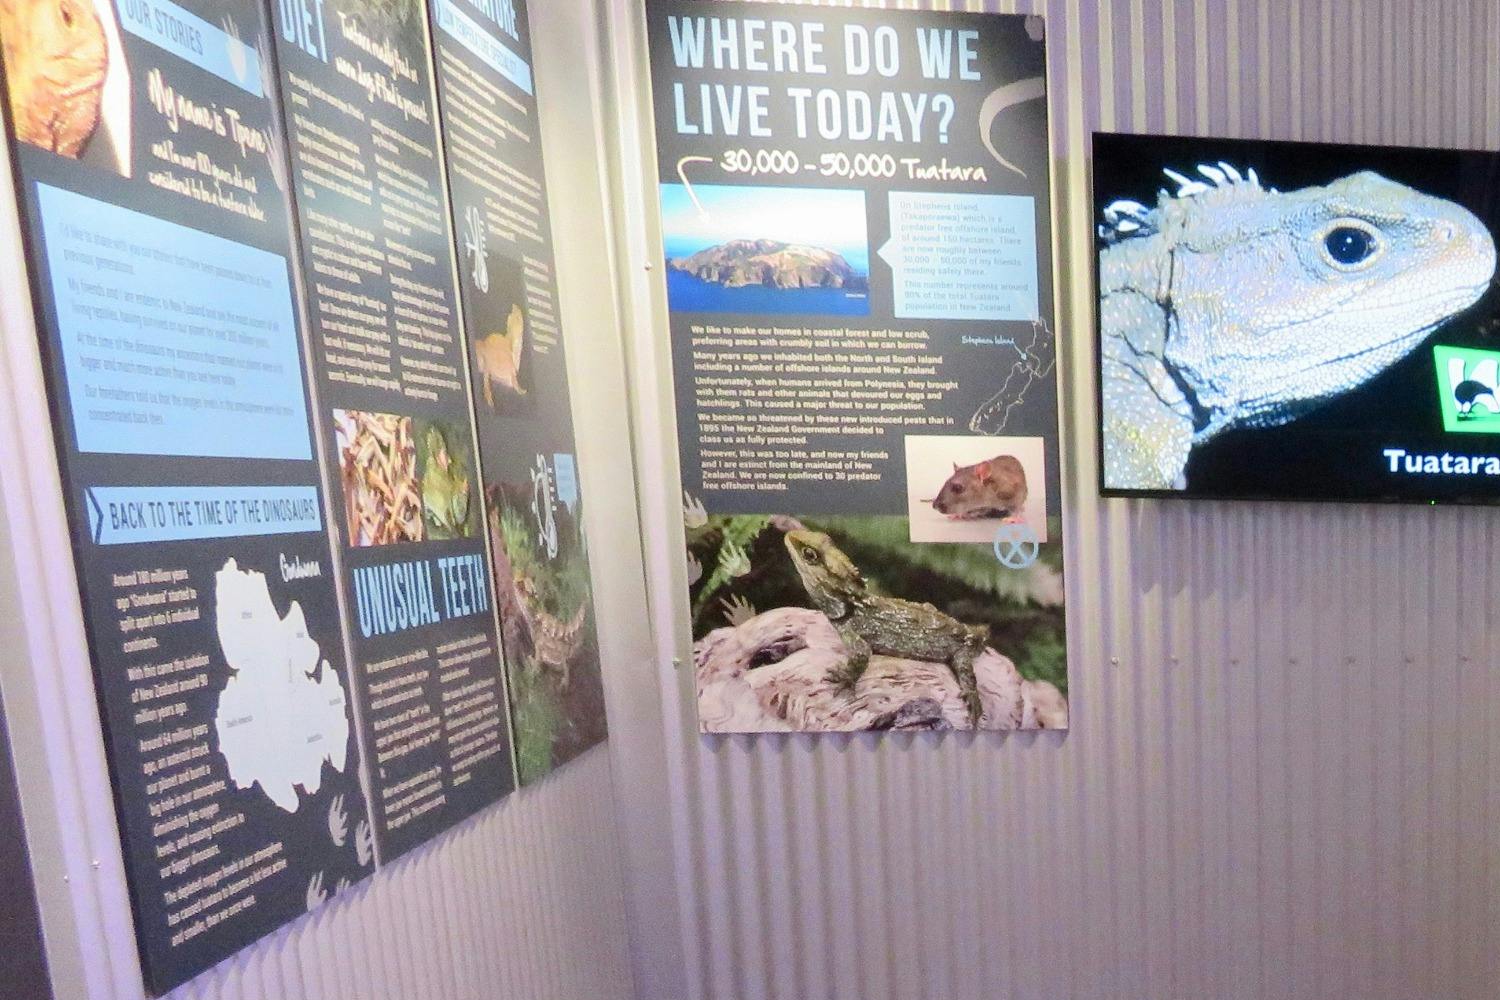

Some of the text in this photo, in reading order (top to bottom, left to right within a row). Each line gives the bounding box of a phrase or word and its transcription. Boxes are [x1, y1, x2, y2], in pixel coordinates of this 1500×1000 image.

[125, 0, 204, 56] OUR STORIES
[279, 0, 328, 64] DIET
[668, 15, 982, 81] WHERE DO WE
[674, 83, 956, 144] LIVE TODAY?
[720, 149, 799, 176] 30,000
[820, 152, 897, 180] 50,000
[900, 157, 988, 183] Tuatara
[691, 326, 704, 334] We
[705, 326, 721, 335] like
[733, 326, 757, 335] make
[773, 327, 802, 335] homes
[803, 327, 812, 335] in
[813, 327, 844, 337] coastal
[845, 328, 870, 338] forest
[871, 329, 887, 338] and
[888, 329, 903, 338] low
[904, 329, 930, 339] scrub,
[692, 336, 734, 347] preferring
[759, 338, 778, 346] with
[779, 339, 813, 348] crumbly
[814, 339, 830, 347] soil
[840, 340, 866, 348] which
[897, 340, 928, 350] burrow.
[693, 351, 717, 361] Many
[717, 353, 741, 361] years
[742, 353, 759, 362] ago
[773, 352, 813, 360] inhabited
[814, 352, 833, 362] both
[834, 354, 848, 362] the
[850, 354, 873, 363] North
[874, 355, 891, 363] and
[892, 355, 916, 363] South
[693, 362, 733, 373] including
[741, 363, 773, 371] number
[774, 363, 784, 372] of
[785, 363, 820, 372] offshore
[821, 365, 851, 373] islands
[852, 366, 882, 374] around
[883, 366, 901, 374] New
[902, 366, 938, 375] Zealand.
[695, 376, 959, 391] Unfortunately, when humans arrived from Polynesia, they brought
[109, 499, 316, 530] BACK TO THE TIME OF THE DINOSAURS
[353, 554, 488, 638] UNUSUAL TEETH
